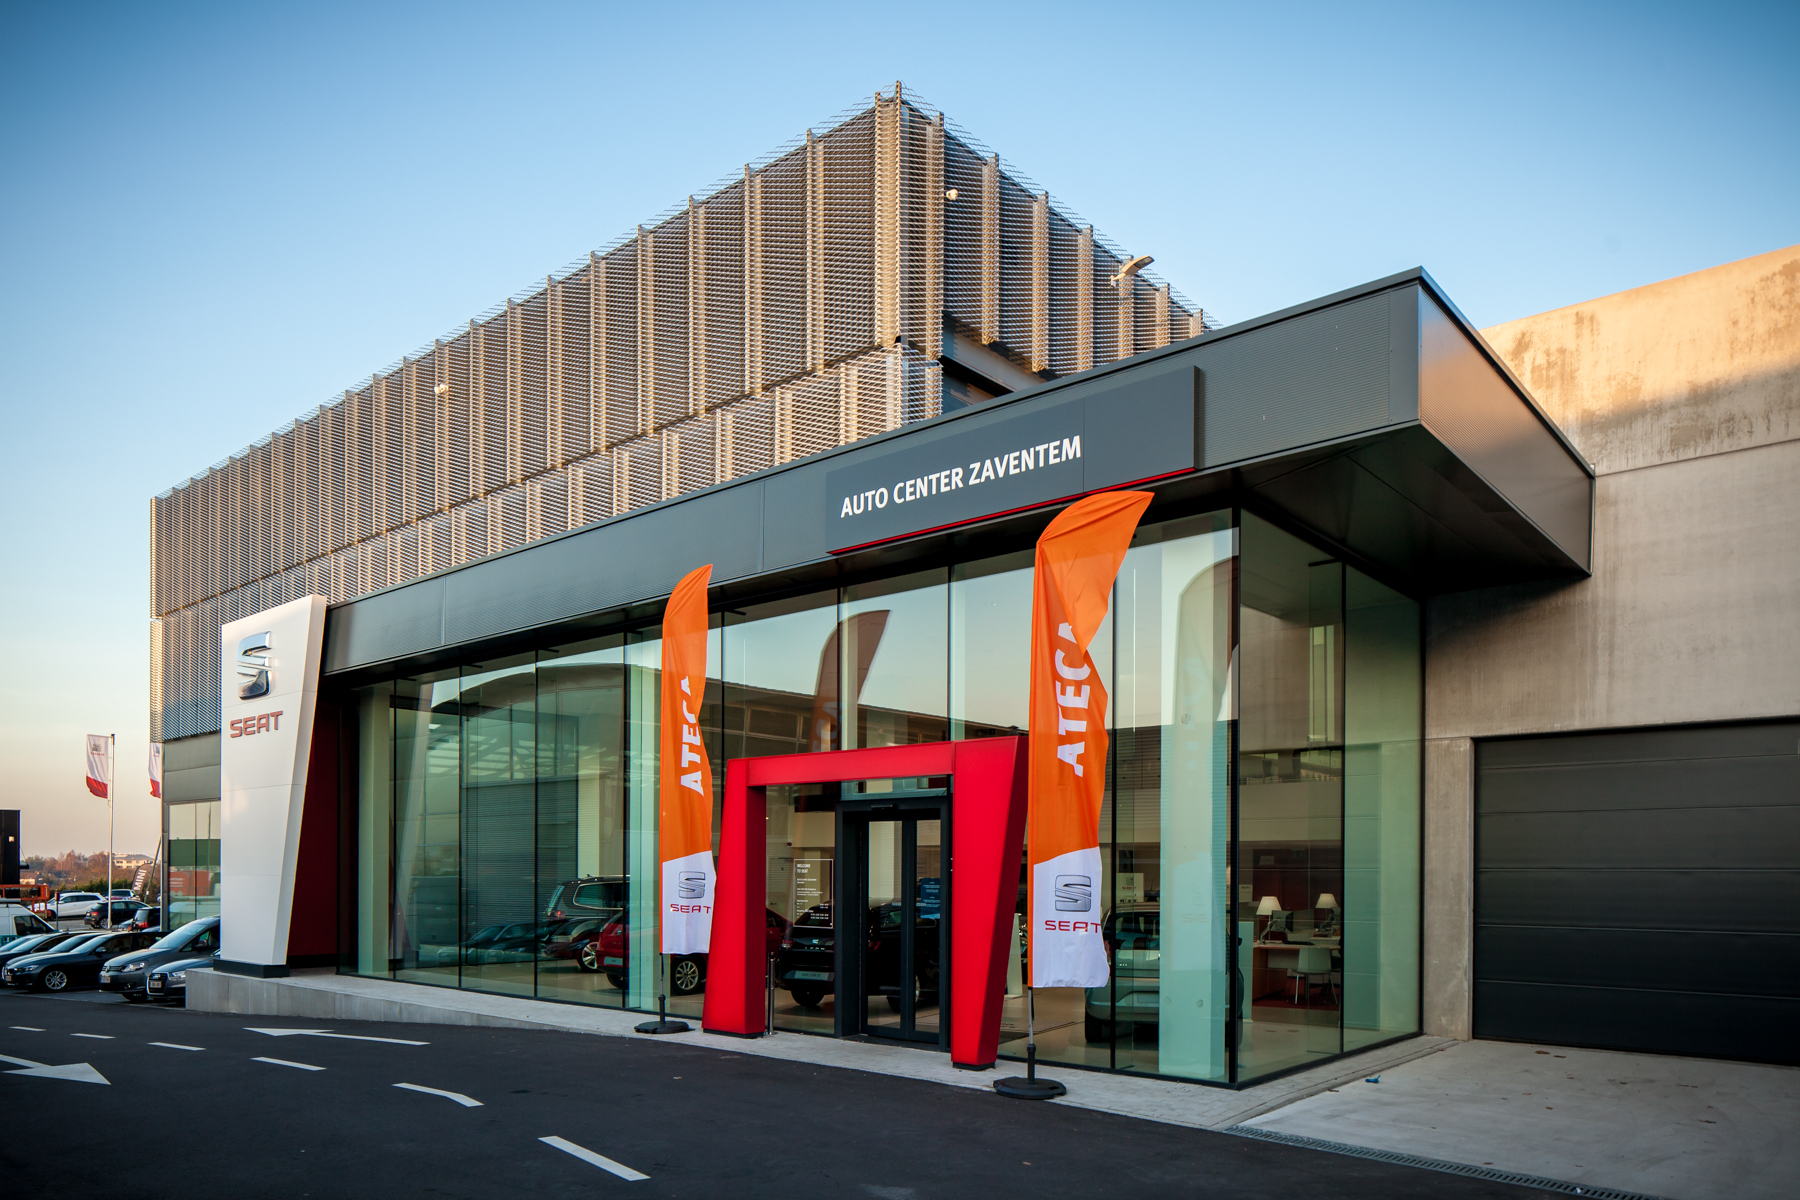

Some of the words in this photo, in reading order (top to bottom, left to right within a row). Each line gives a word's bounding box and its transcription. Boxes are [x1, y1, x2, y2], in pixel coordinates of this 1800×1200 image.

[840, 487, 888, 518] AUTO
[893, 467, 964, 504] CENTER
[968, 435, 1081, 486] ZAVENTEM
[230, 710, 283, 738] SEAT
[133, 869, 147, 891] MINI
[670, 903, 712, 914] SEAT
[1044, 920, 1101, 934] SEAT
